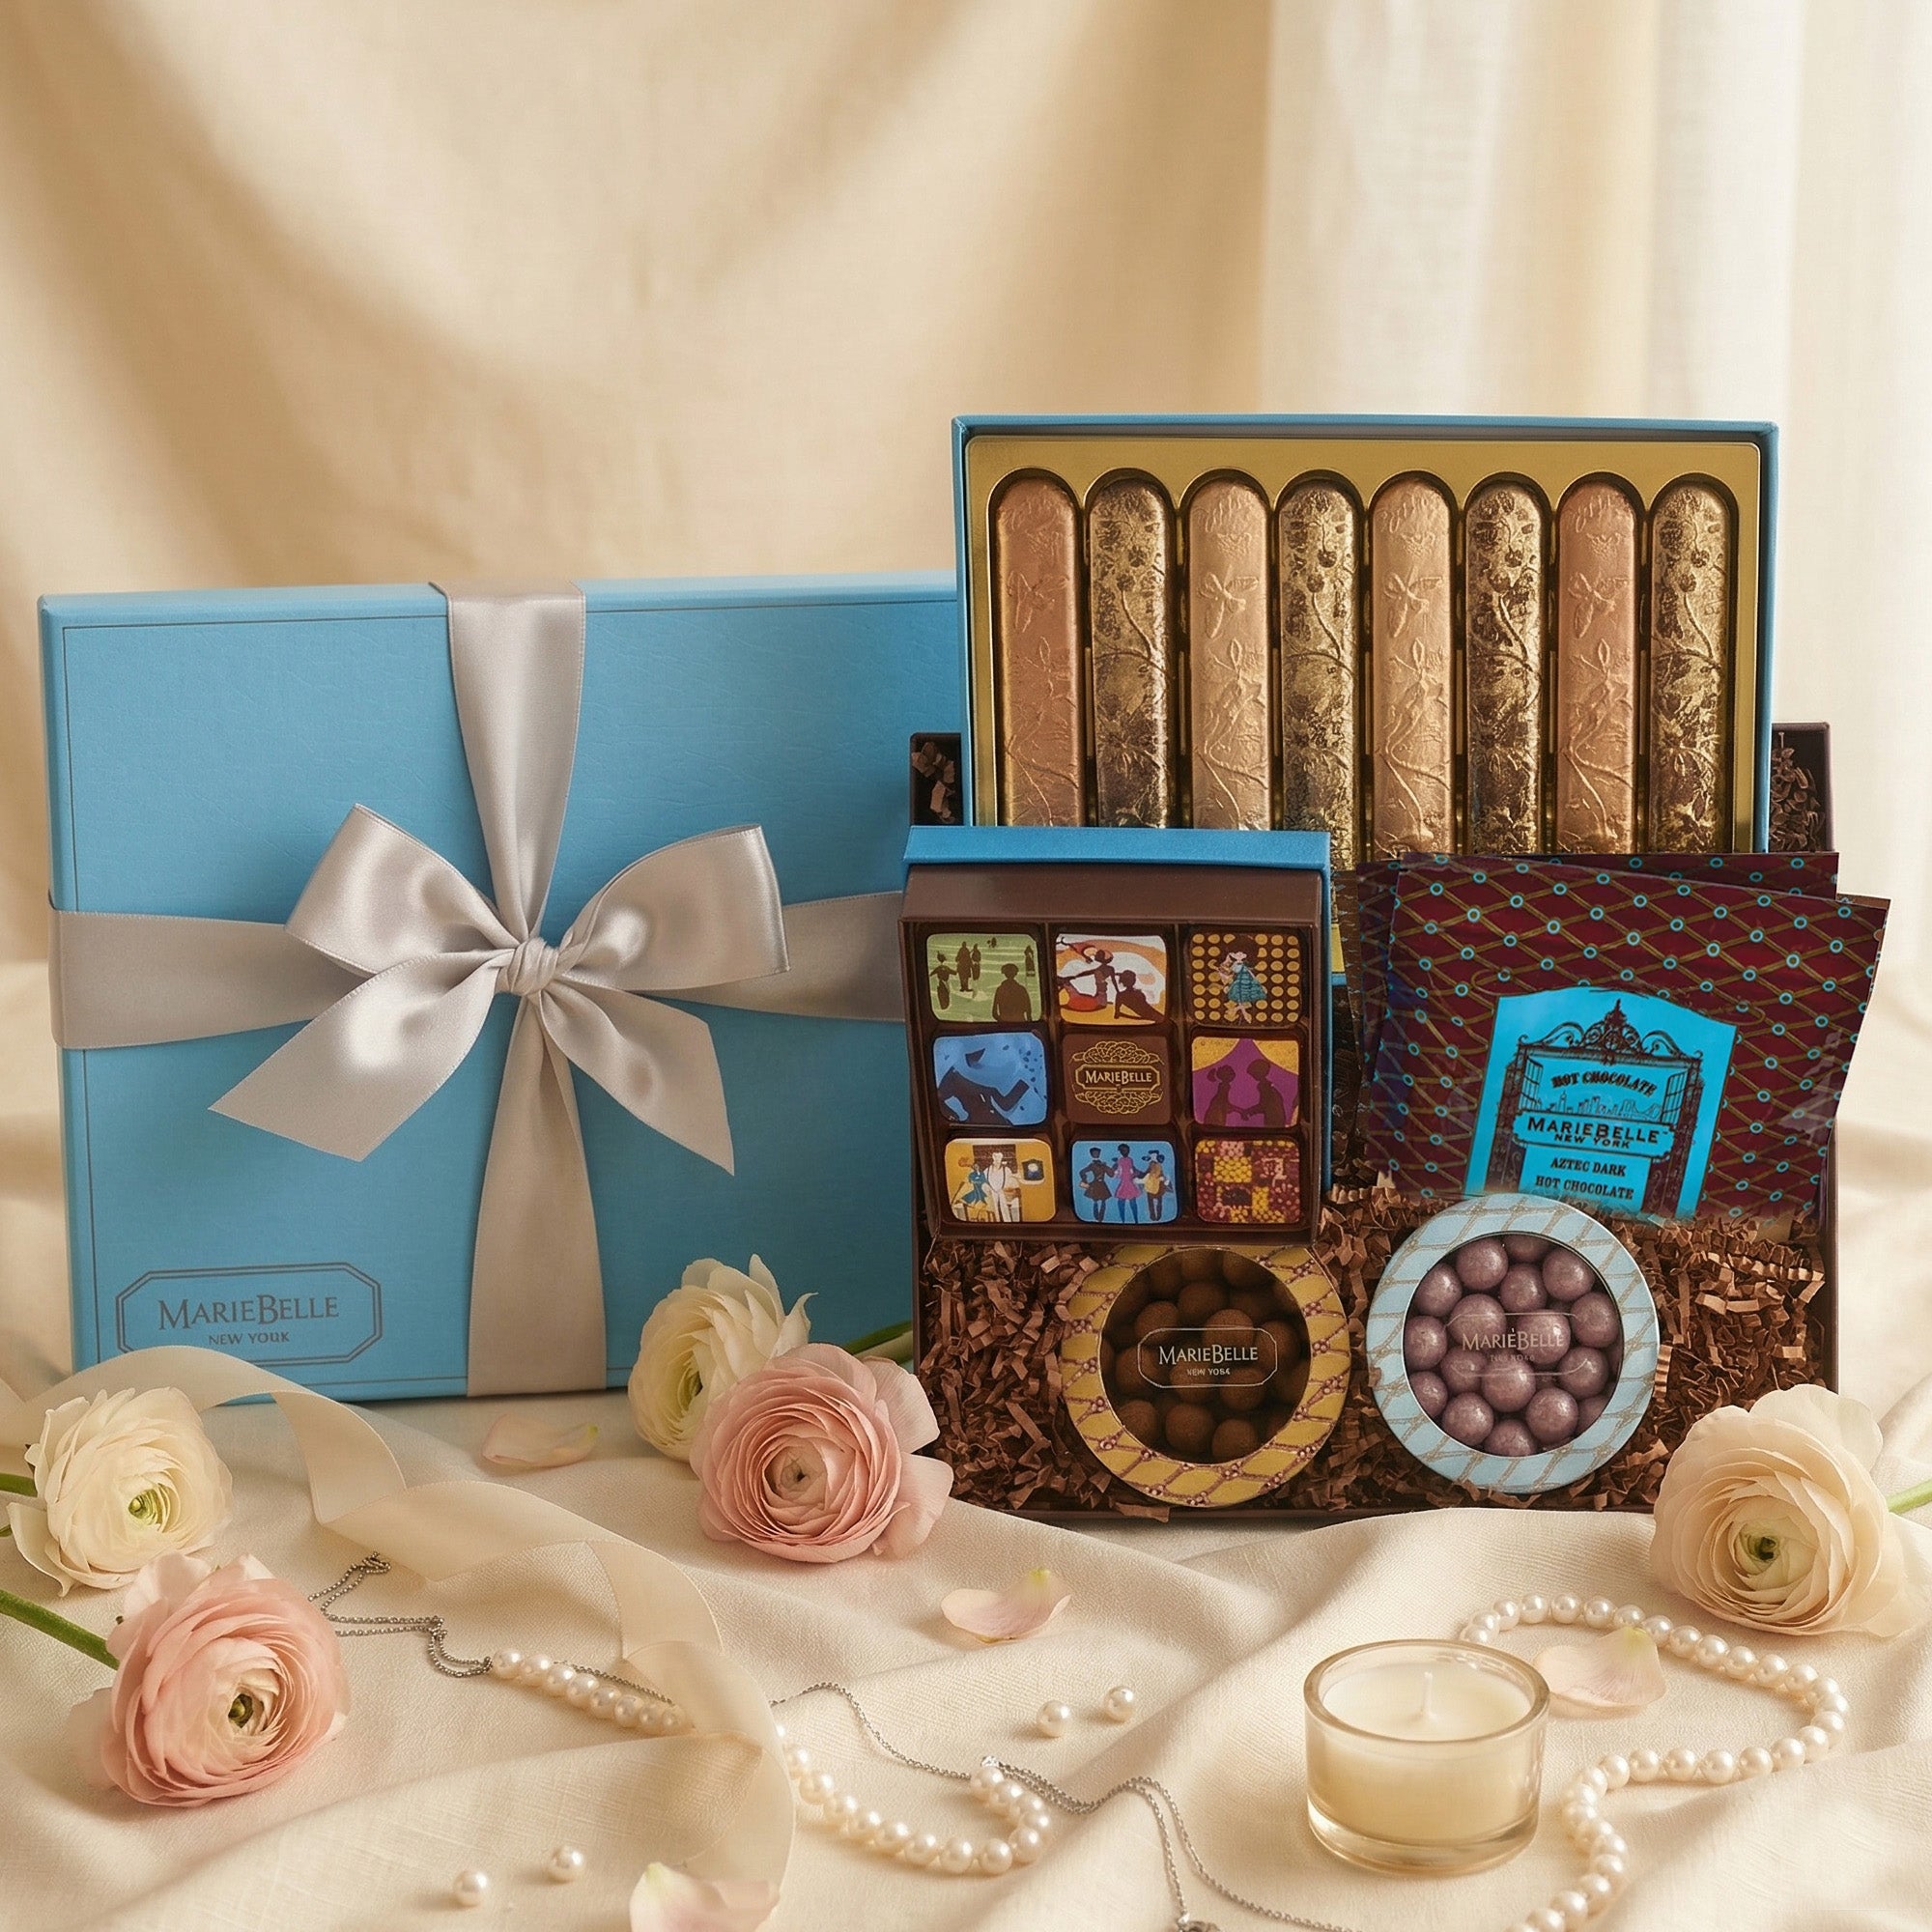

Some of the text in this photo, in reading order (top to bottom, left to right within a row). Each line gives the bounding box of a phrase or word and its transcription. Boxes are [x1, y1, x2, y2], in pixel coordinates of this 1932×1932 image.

[1085, 1070, 1152, 1084] MARIEBELLE
[1550, 1070, 1658, 1097] HOT CHOCOLATE
[1554, 1133, 1631, 1149] NEW YORK
[1550, 1157, 1627, 1178] AZTEC DARK
[1535, 1175, 1634, 1200] HOT CHOCOLATE
[158, 1294, 339, 1330] MARIEBELLE
[209, 1334, 242, 1345] NEW
[1159, 1344, 1259, 1364] MARIEBELLE
